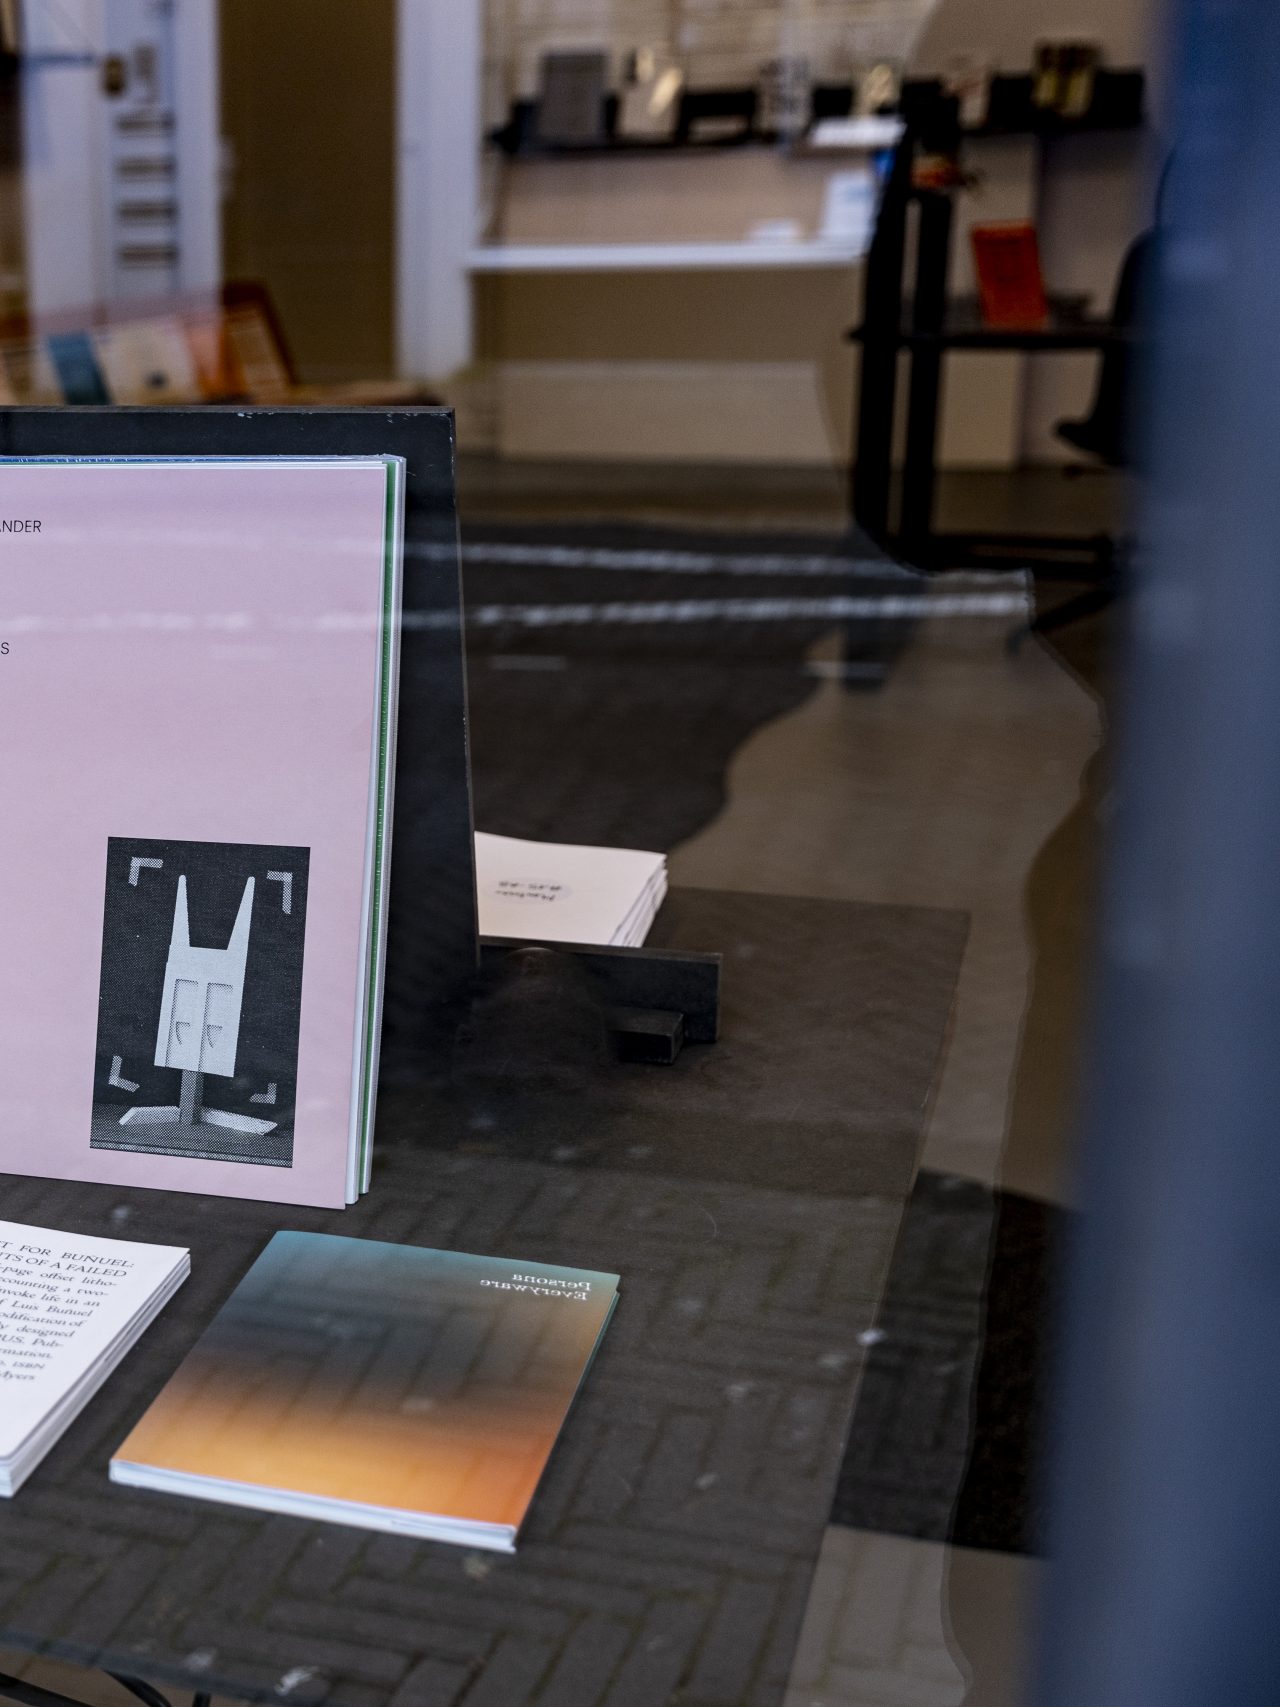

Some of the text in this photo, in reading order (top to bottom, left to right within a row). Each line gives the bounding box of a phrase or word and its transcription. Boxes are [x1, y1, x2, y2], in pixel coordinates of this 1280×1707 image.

[19, 1244, 52, 1257] FOR
[25, 1257, 49, 1266] OF
[65, 1264, 127, 1277] FAILED
[39, 1272, 75, 1282] offset
